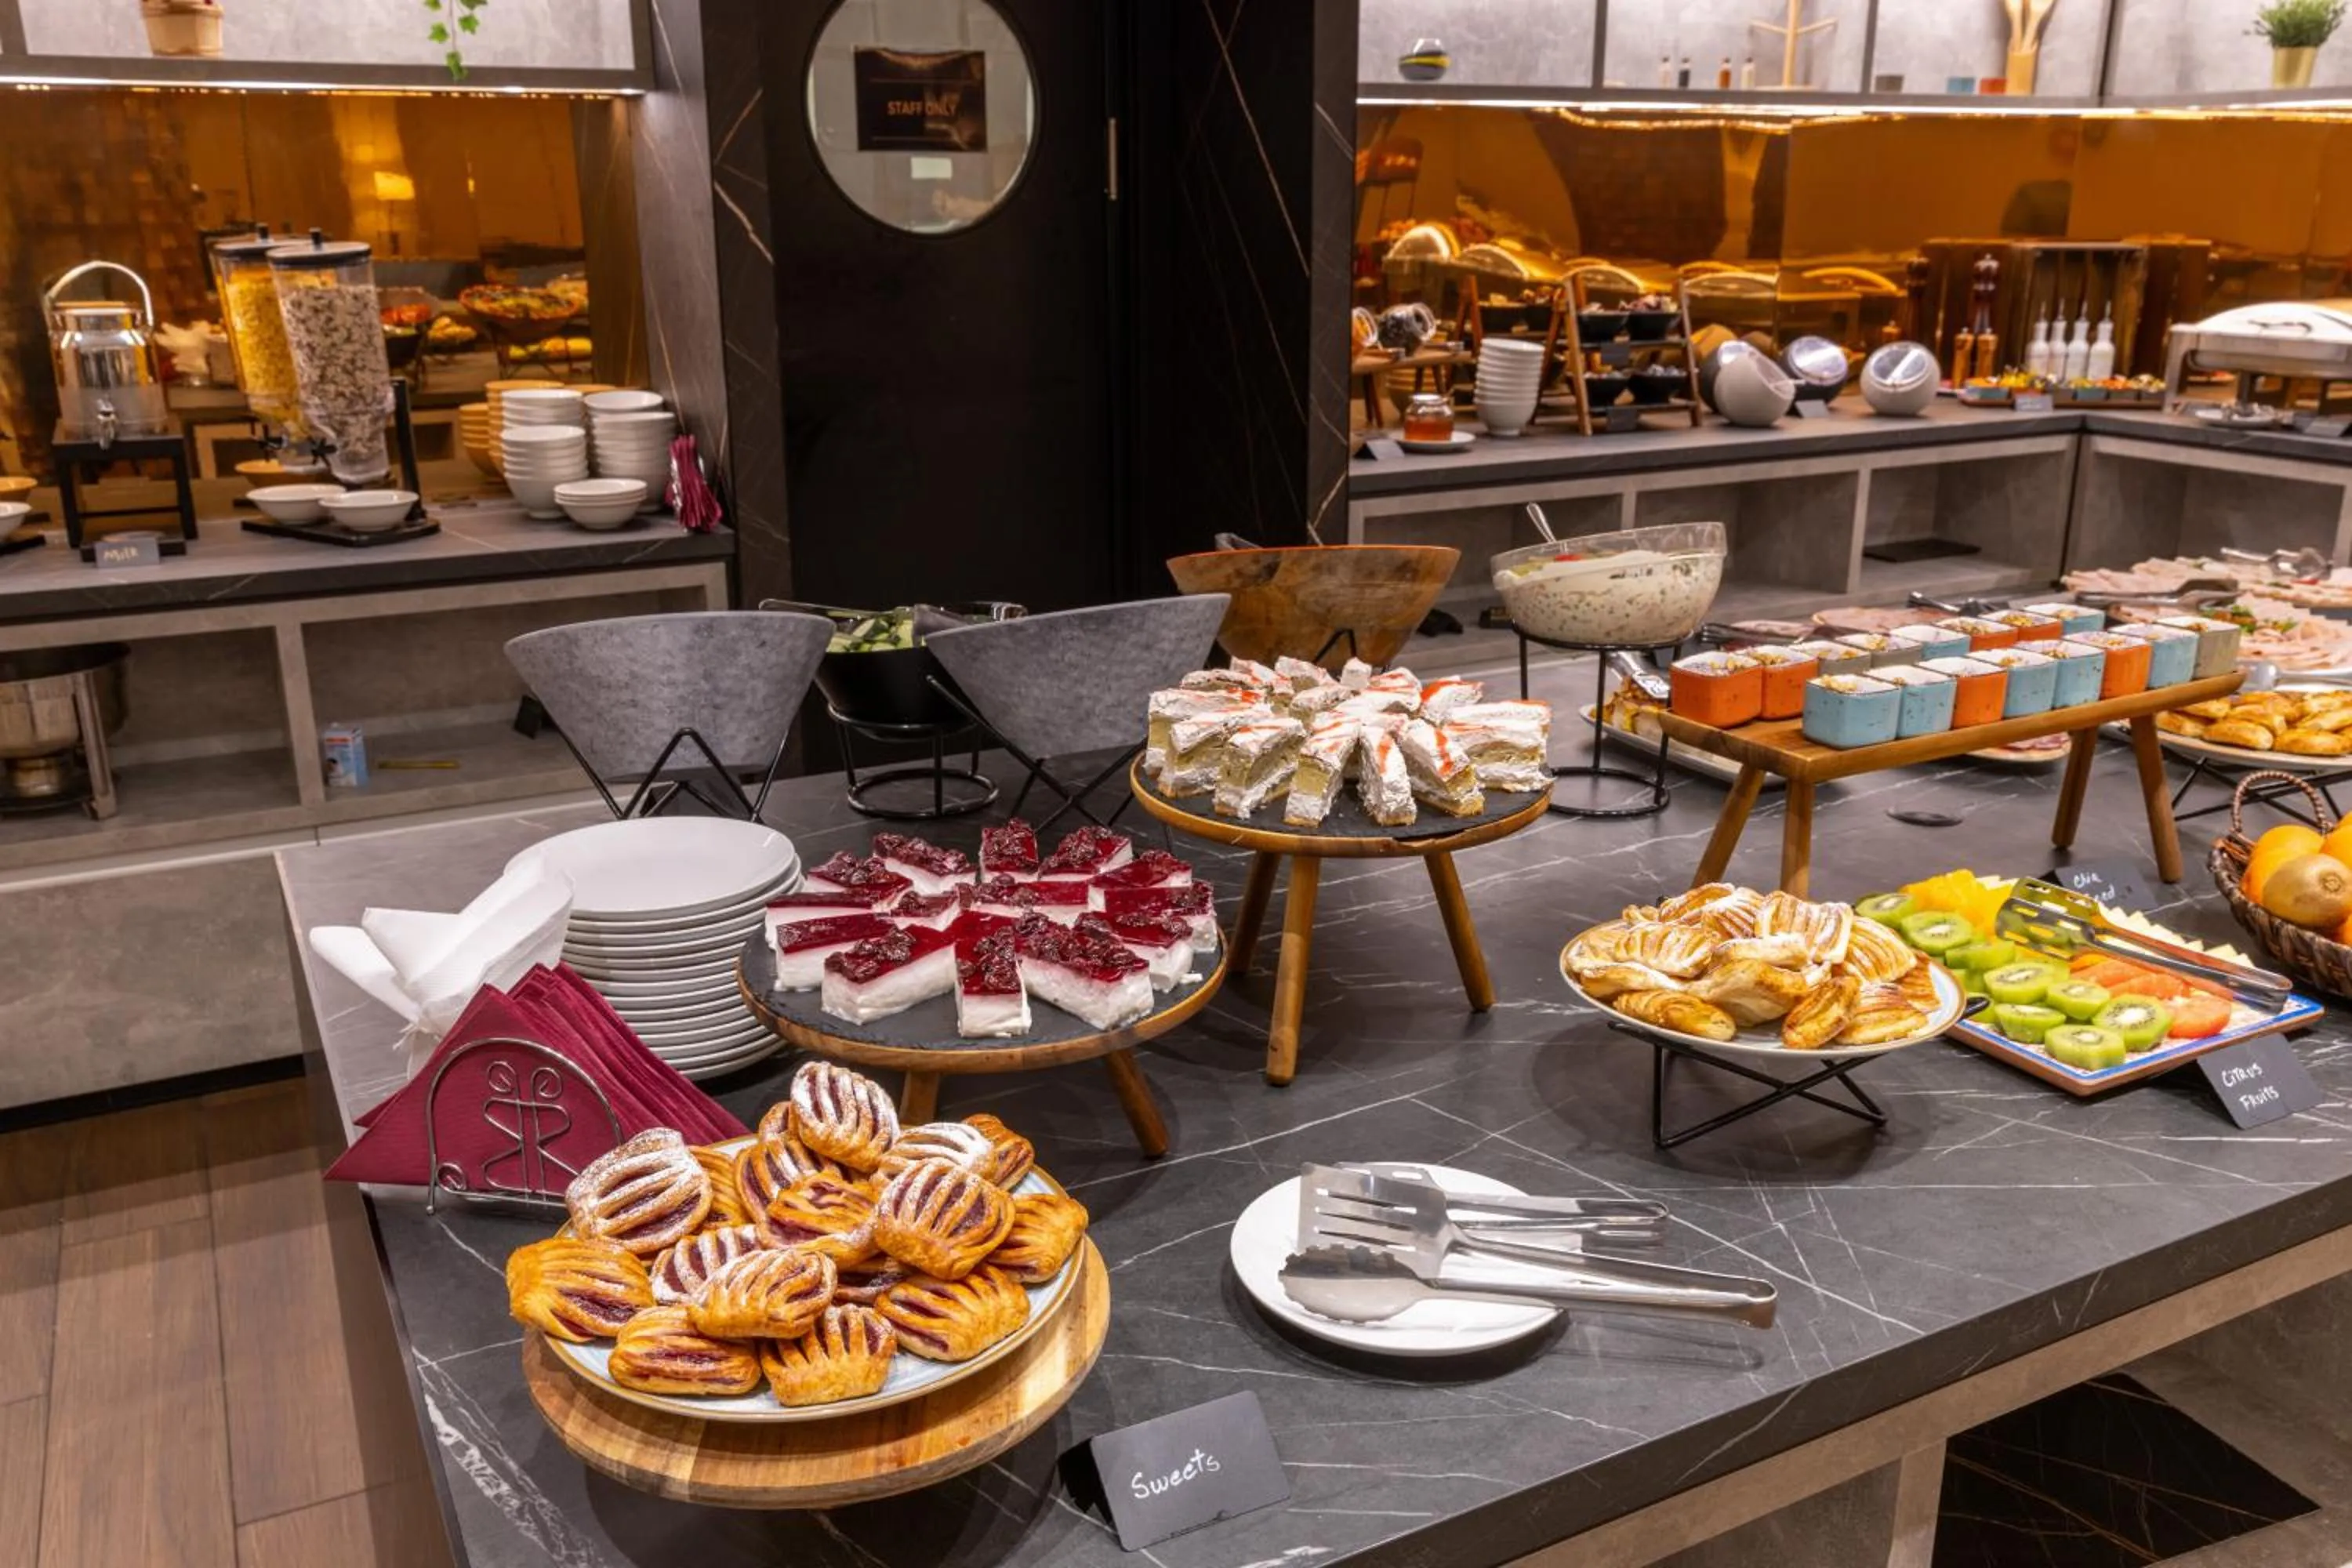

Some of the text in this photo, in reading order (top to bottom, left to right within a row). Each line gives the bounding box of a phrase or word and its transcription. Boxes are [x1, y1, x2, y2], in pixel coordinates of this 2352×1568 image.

[887, 100, 957, 117] STAFF ONLY
[1131, 1448, 1221, 1499] Sweets
